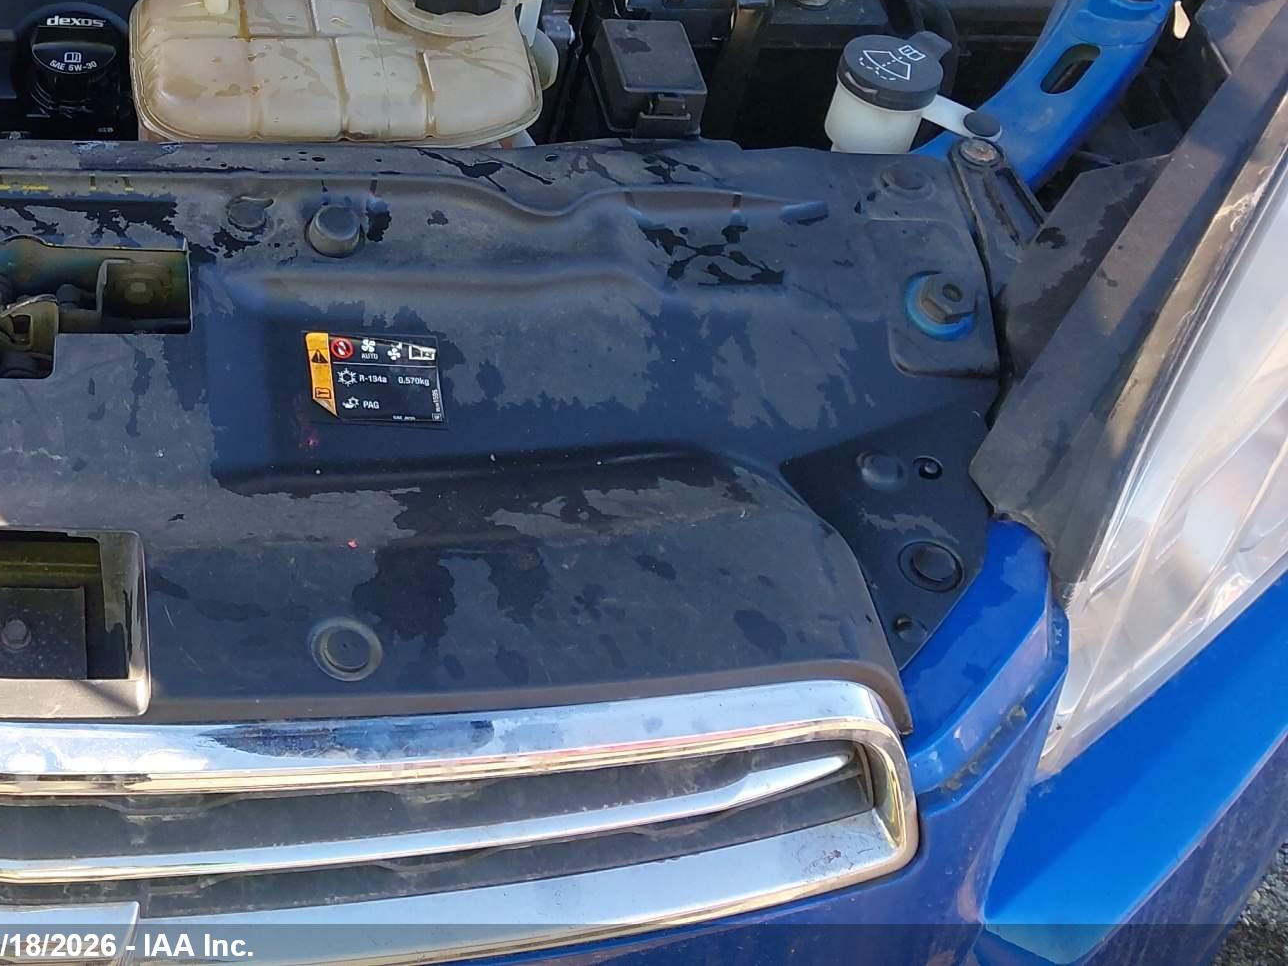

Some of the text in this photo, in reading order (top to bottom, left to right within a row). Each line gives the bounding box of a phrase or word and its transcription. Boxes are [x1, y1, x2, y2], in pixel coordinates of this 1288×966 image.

[46, 15, 104, 27] dexos
[49, 59, 97, 72] SAE 5W-30
[359, 374, 430, 387] R-134a 0.570kg
[363, 400, 380, 409] PAG
